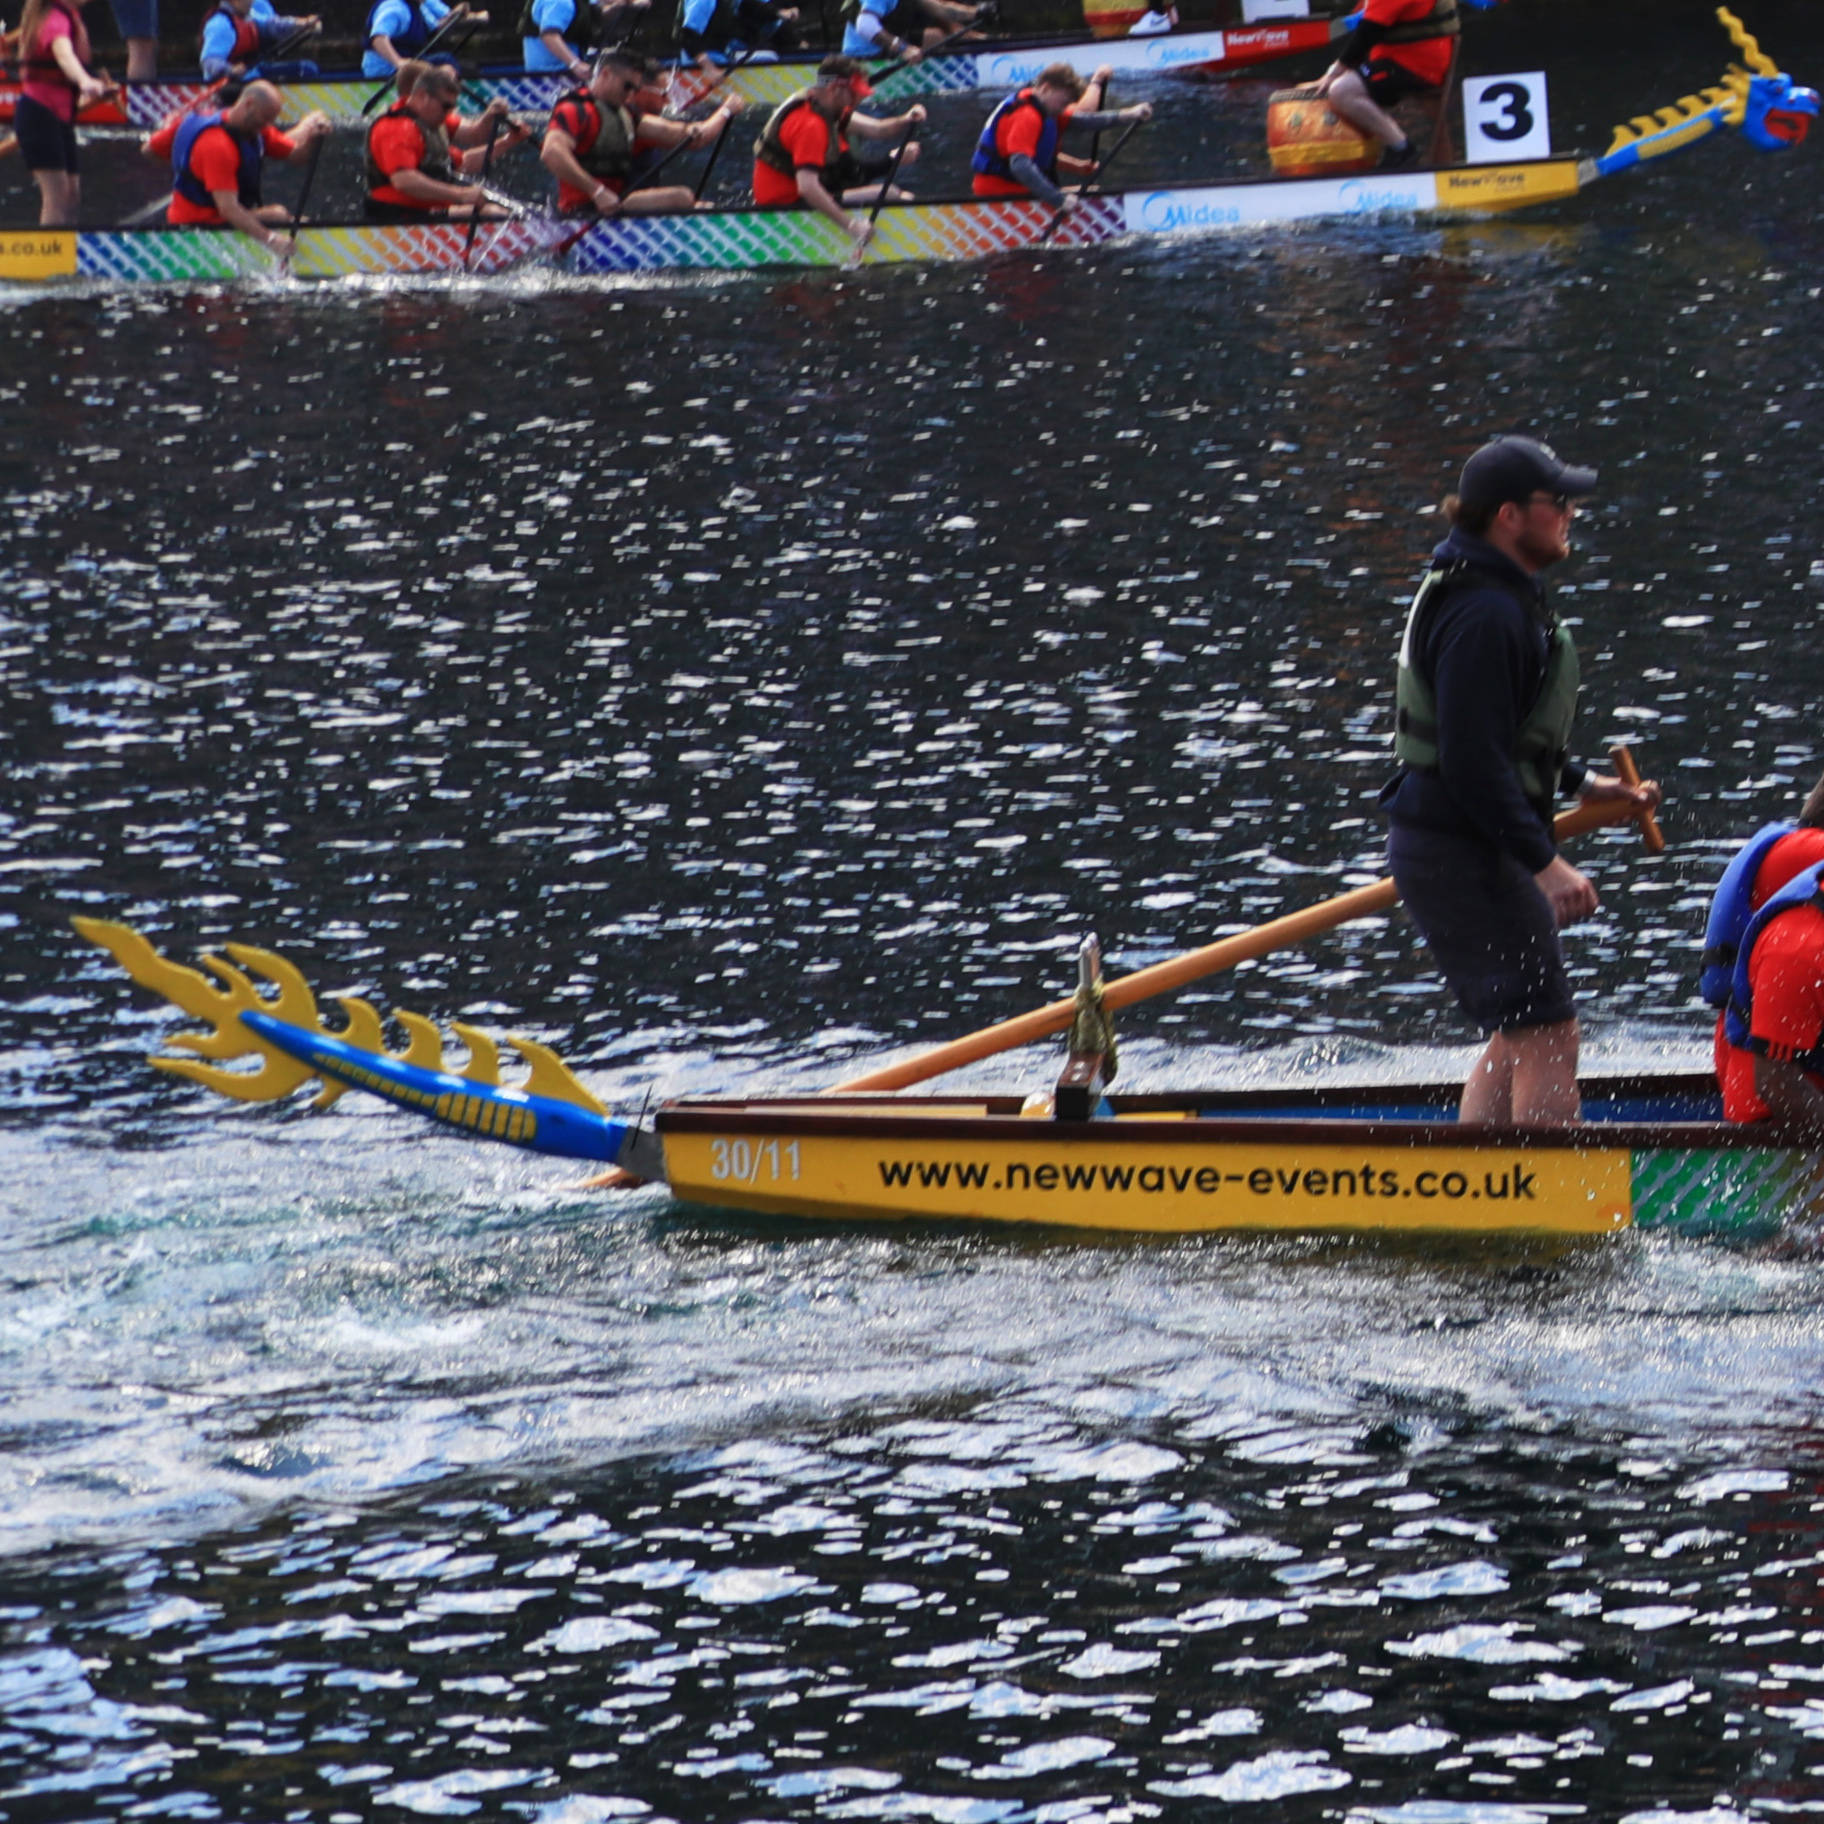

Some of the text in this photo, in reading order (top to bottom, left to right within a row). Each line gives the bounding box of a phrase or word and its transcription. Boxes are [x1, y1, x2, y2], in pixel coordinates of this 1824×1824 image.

[1480, 82, 1534, 141] 3
[1143, 197, 1240, 232] Midea
[710, 1137, 801, 1184] 30/11
[879, 1160, 1537, 1201] www.newwave-events.co.uk
